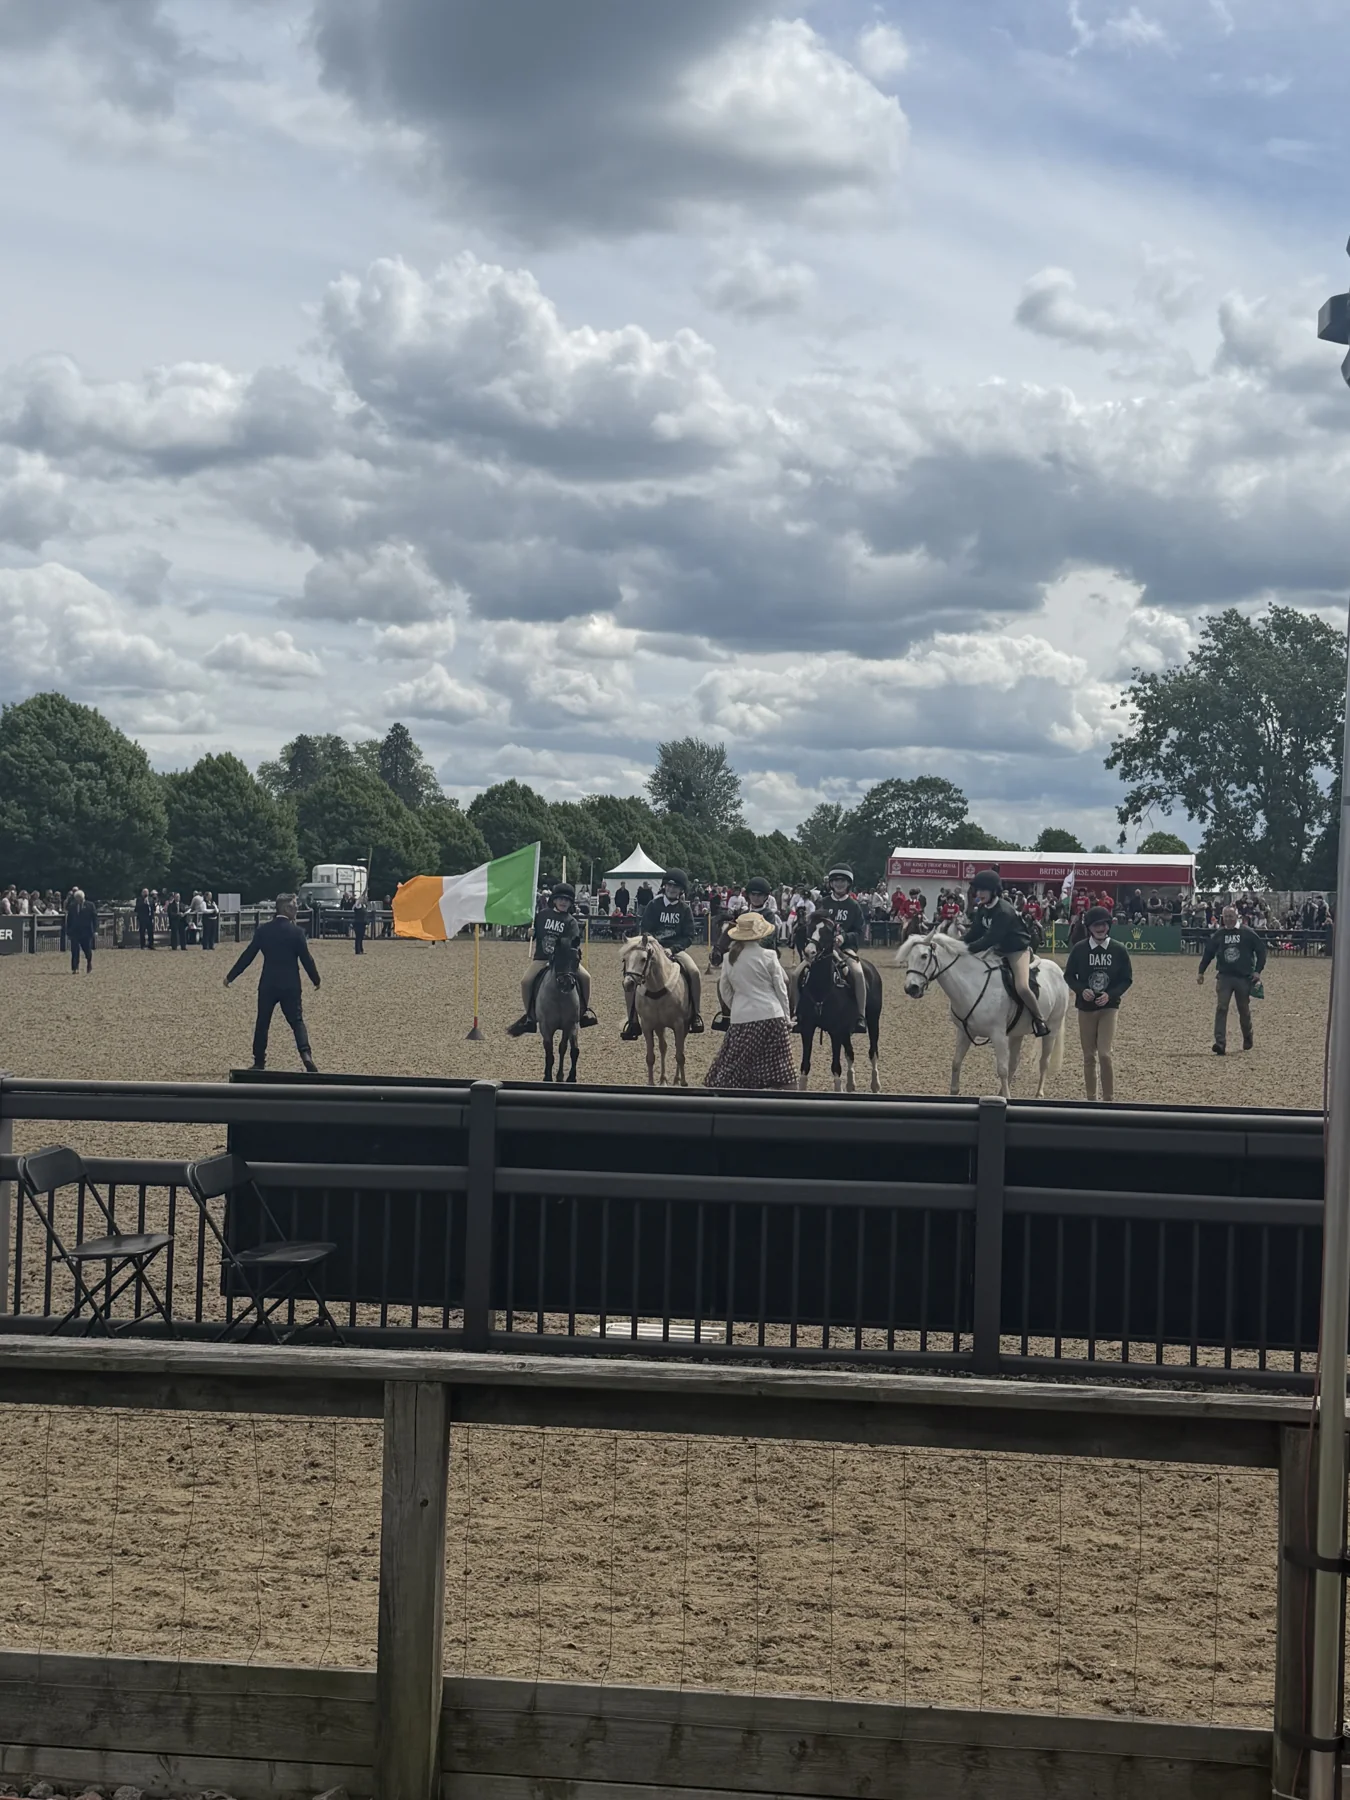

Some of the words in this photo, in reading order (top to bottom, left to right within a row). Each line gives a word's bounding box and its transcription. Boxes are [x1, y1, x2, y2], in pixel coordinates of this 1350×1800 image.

[1039, 867, 1065, 875] BRITISH
[1090, 869, 1119, 877] SOCIETY
[1122, 941, 1156, 950] OLEX
[1089, 953, 1112, 966] DAKS
